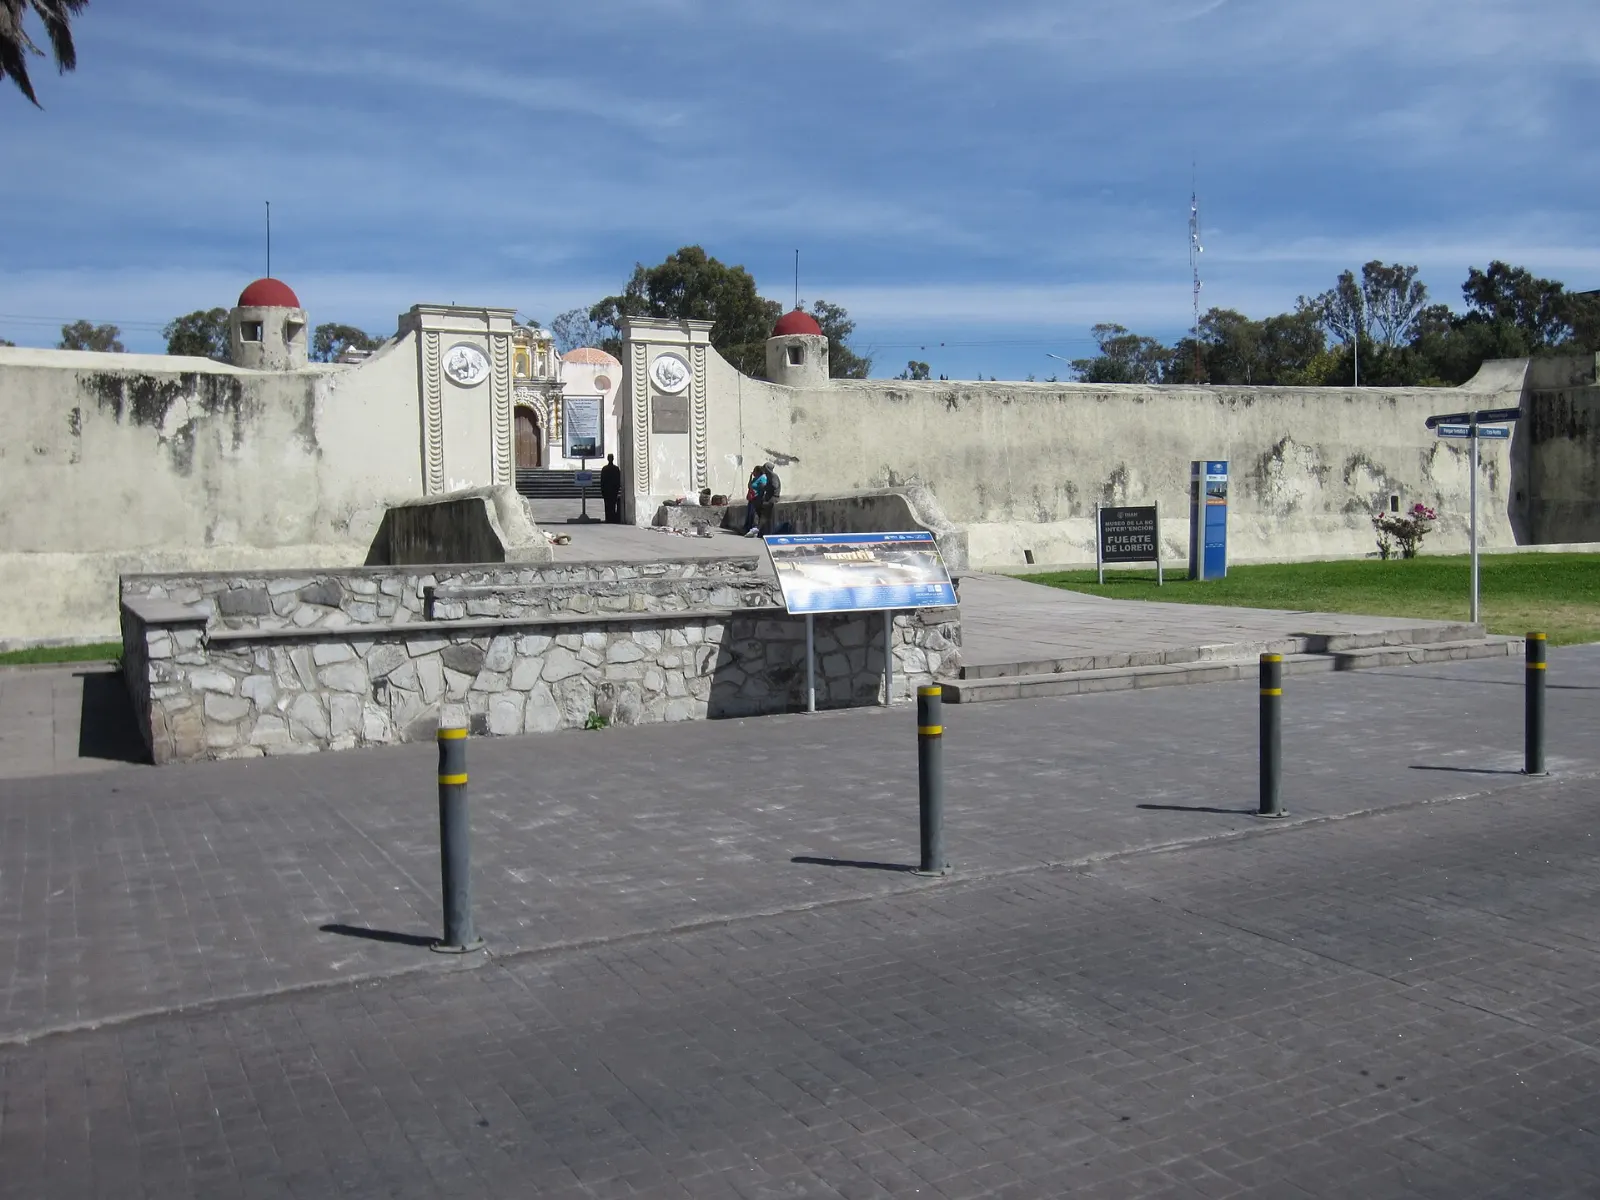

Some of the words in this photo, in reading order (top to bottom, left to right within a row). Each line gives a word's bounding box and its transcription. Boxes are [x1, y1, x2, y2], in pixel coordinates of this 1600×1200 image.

[1107, 535, 1151, 544] FUERTE
[1105, 544, 1117, 553] DE
[1120, 544, 1154, 552] LORETO
